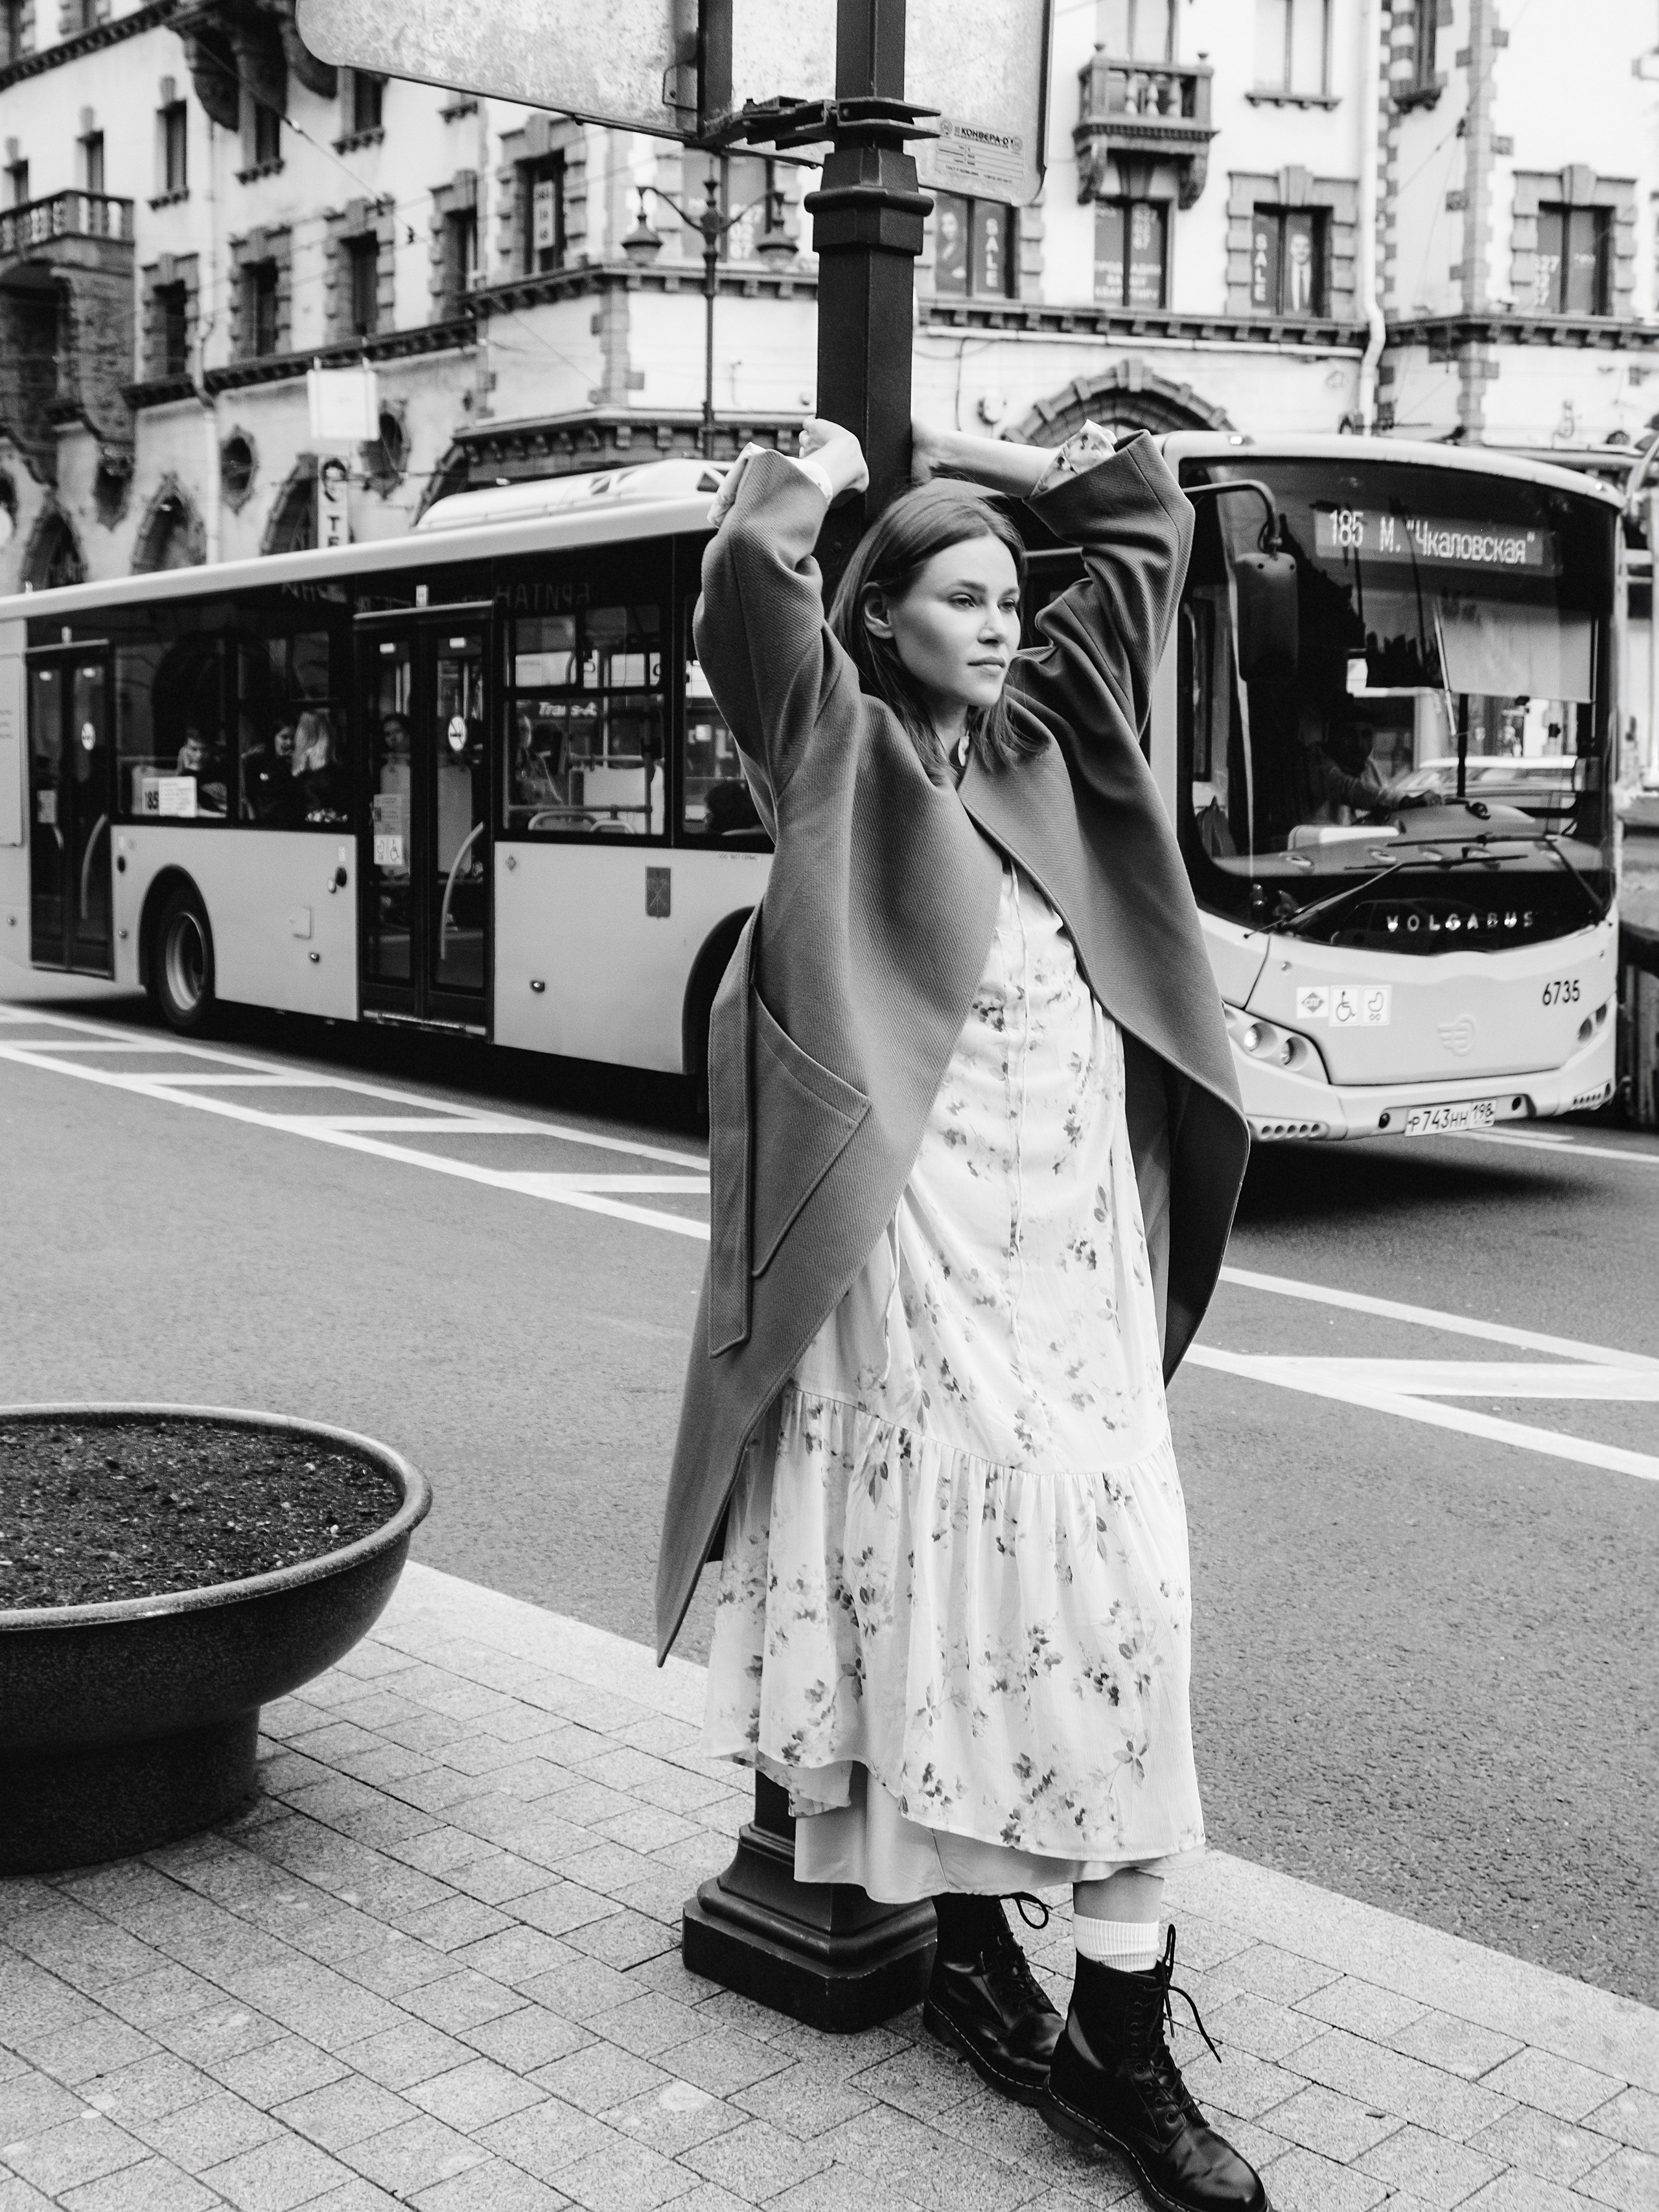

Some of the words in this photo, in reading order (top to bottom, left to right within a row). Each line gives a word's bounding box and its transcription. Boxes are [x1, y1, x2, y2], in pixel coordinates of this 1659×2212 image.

[986, 218, 999, 287] SALE
[1254, 233, 1268, 301] SALE
[1329, 509, 1364, 548] 185
[1379, 516, 1401, 553] М.
[1406, 518, 1535, 565] "Чкаловская"
[1386, 910, 1534, 933] VOLGABUS
[1542, 979, 1581, 1007] 6735
